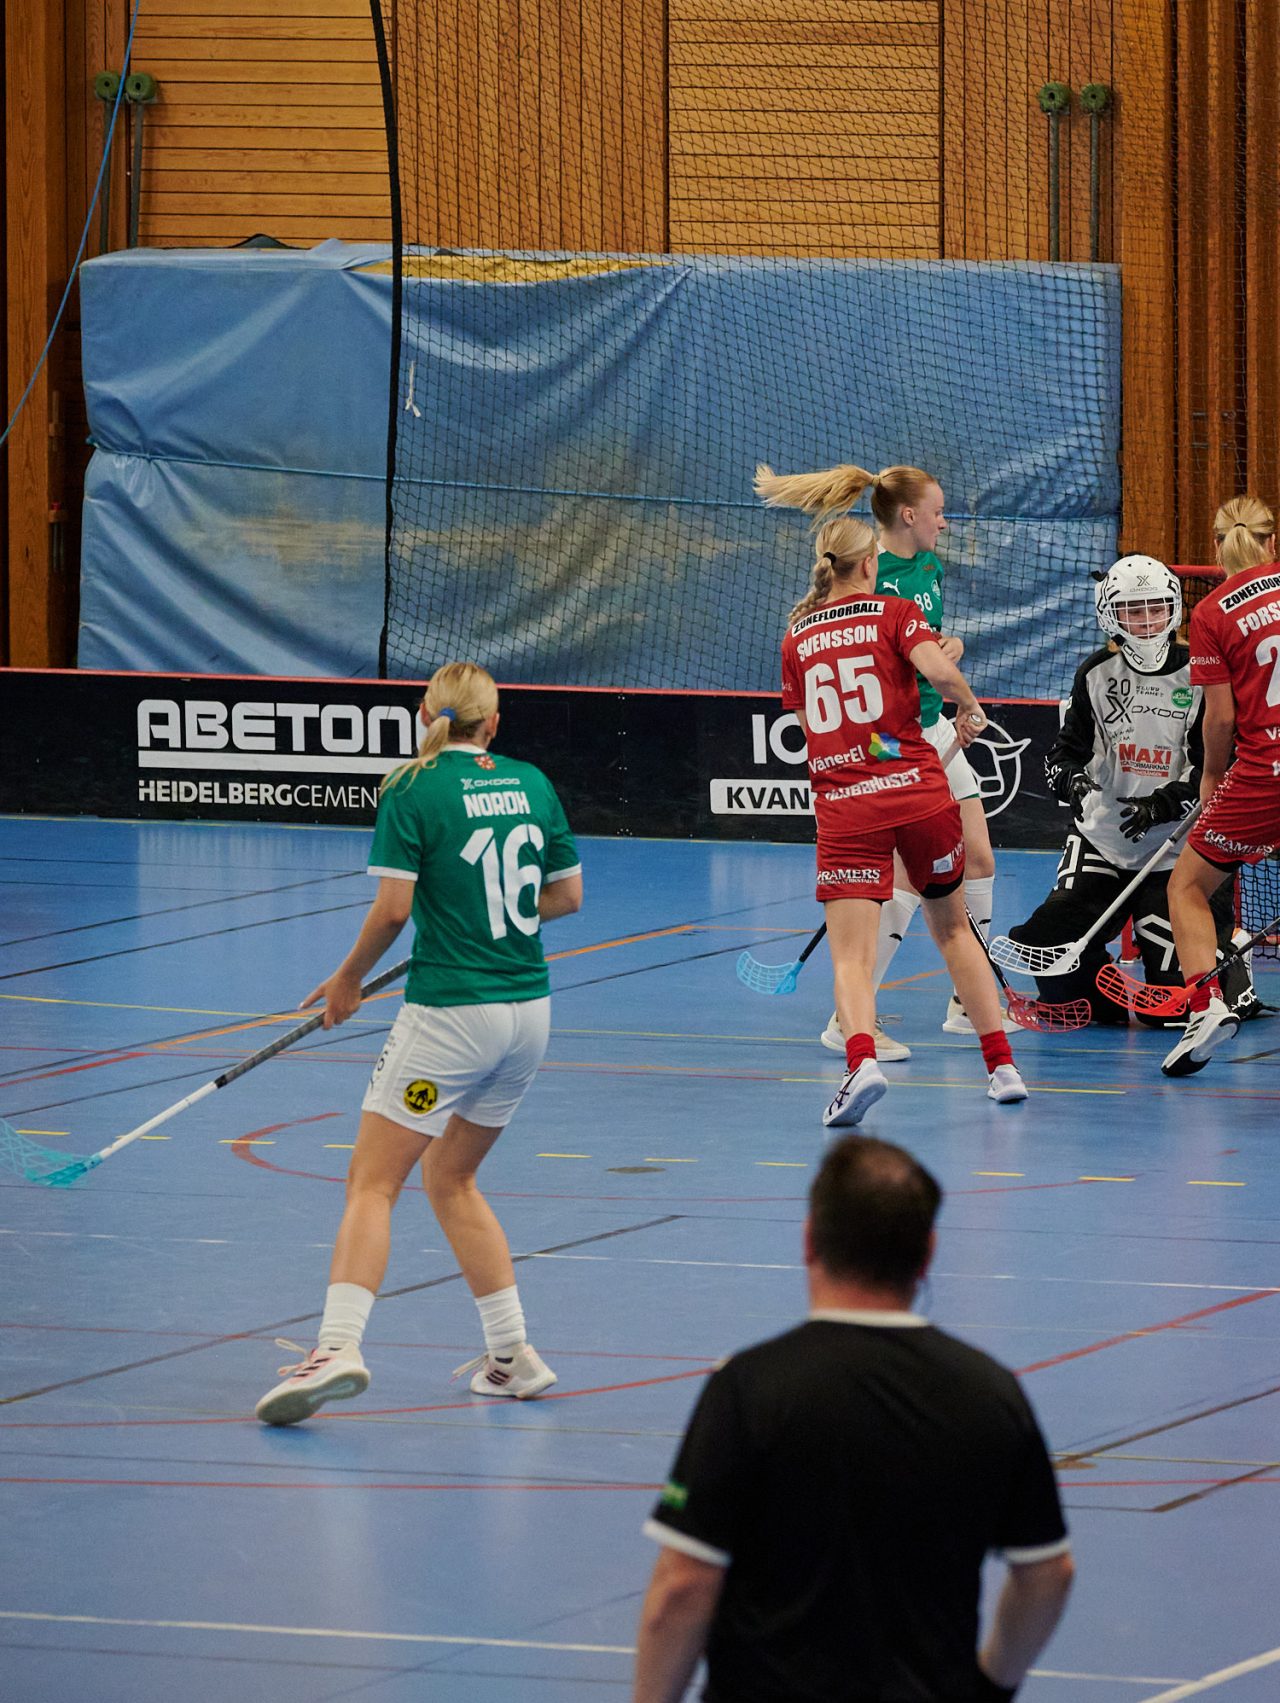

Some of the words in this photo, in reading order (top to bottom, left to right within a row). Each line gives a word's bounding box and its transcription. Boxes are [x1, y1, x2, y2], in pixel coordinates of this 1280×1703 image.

[797, 624, 878, 662] SVENSSON
[804, 654, 884, 734] 65
[1107, 677, 1130, 697] 20
[137, 699, 425, 755] ABETON
[1132, 705, 1187, 720] OXDO
[808, 745, 866, 774] VänerEl
[1119, 743, 1172, 765] MAXI
[463, 791, 531, 818] NORDH
[459, 823, 544, 940] 16
